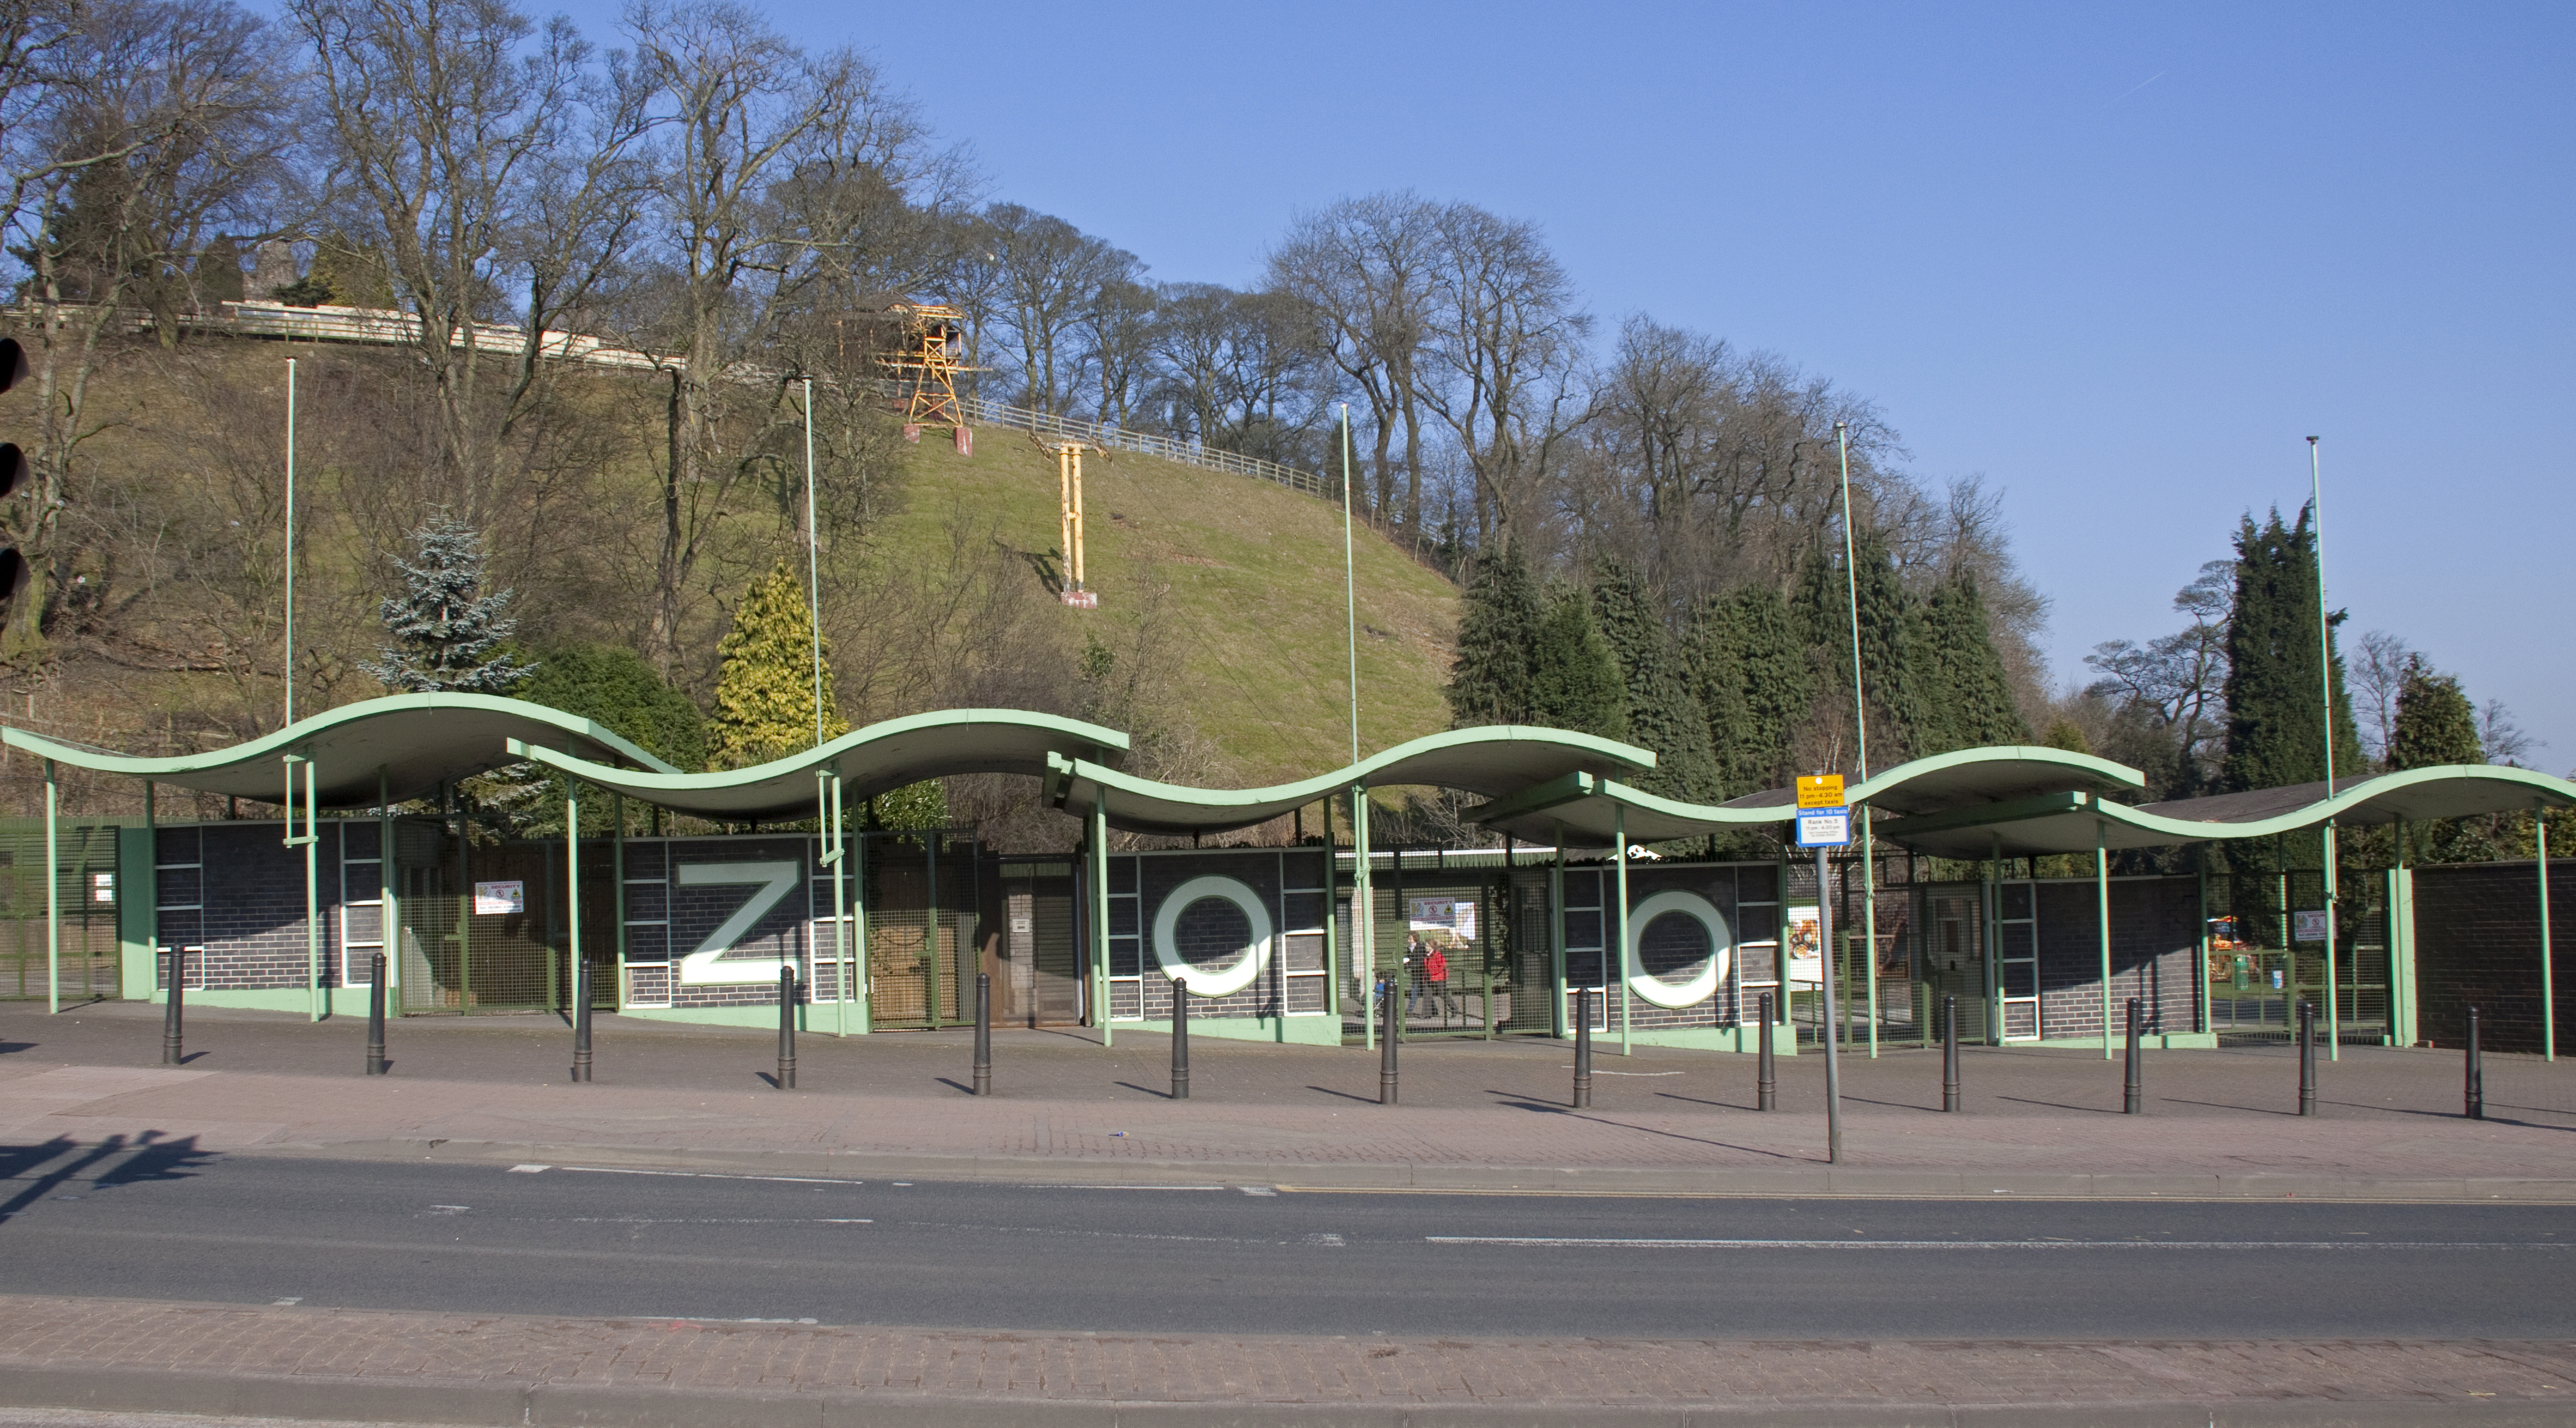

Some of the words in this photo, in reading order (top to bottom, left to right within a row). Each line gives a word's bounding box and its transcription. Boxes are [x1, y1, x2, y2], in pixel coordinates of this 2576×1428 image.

[675, 858, 801, 987] Z
[1151, 873, 1274, 999] O
[1620, 889, 1732, 1011] O
